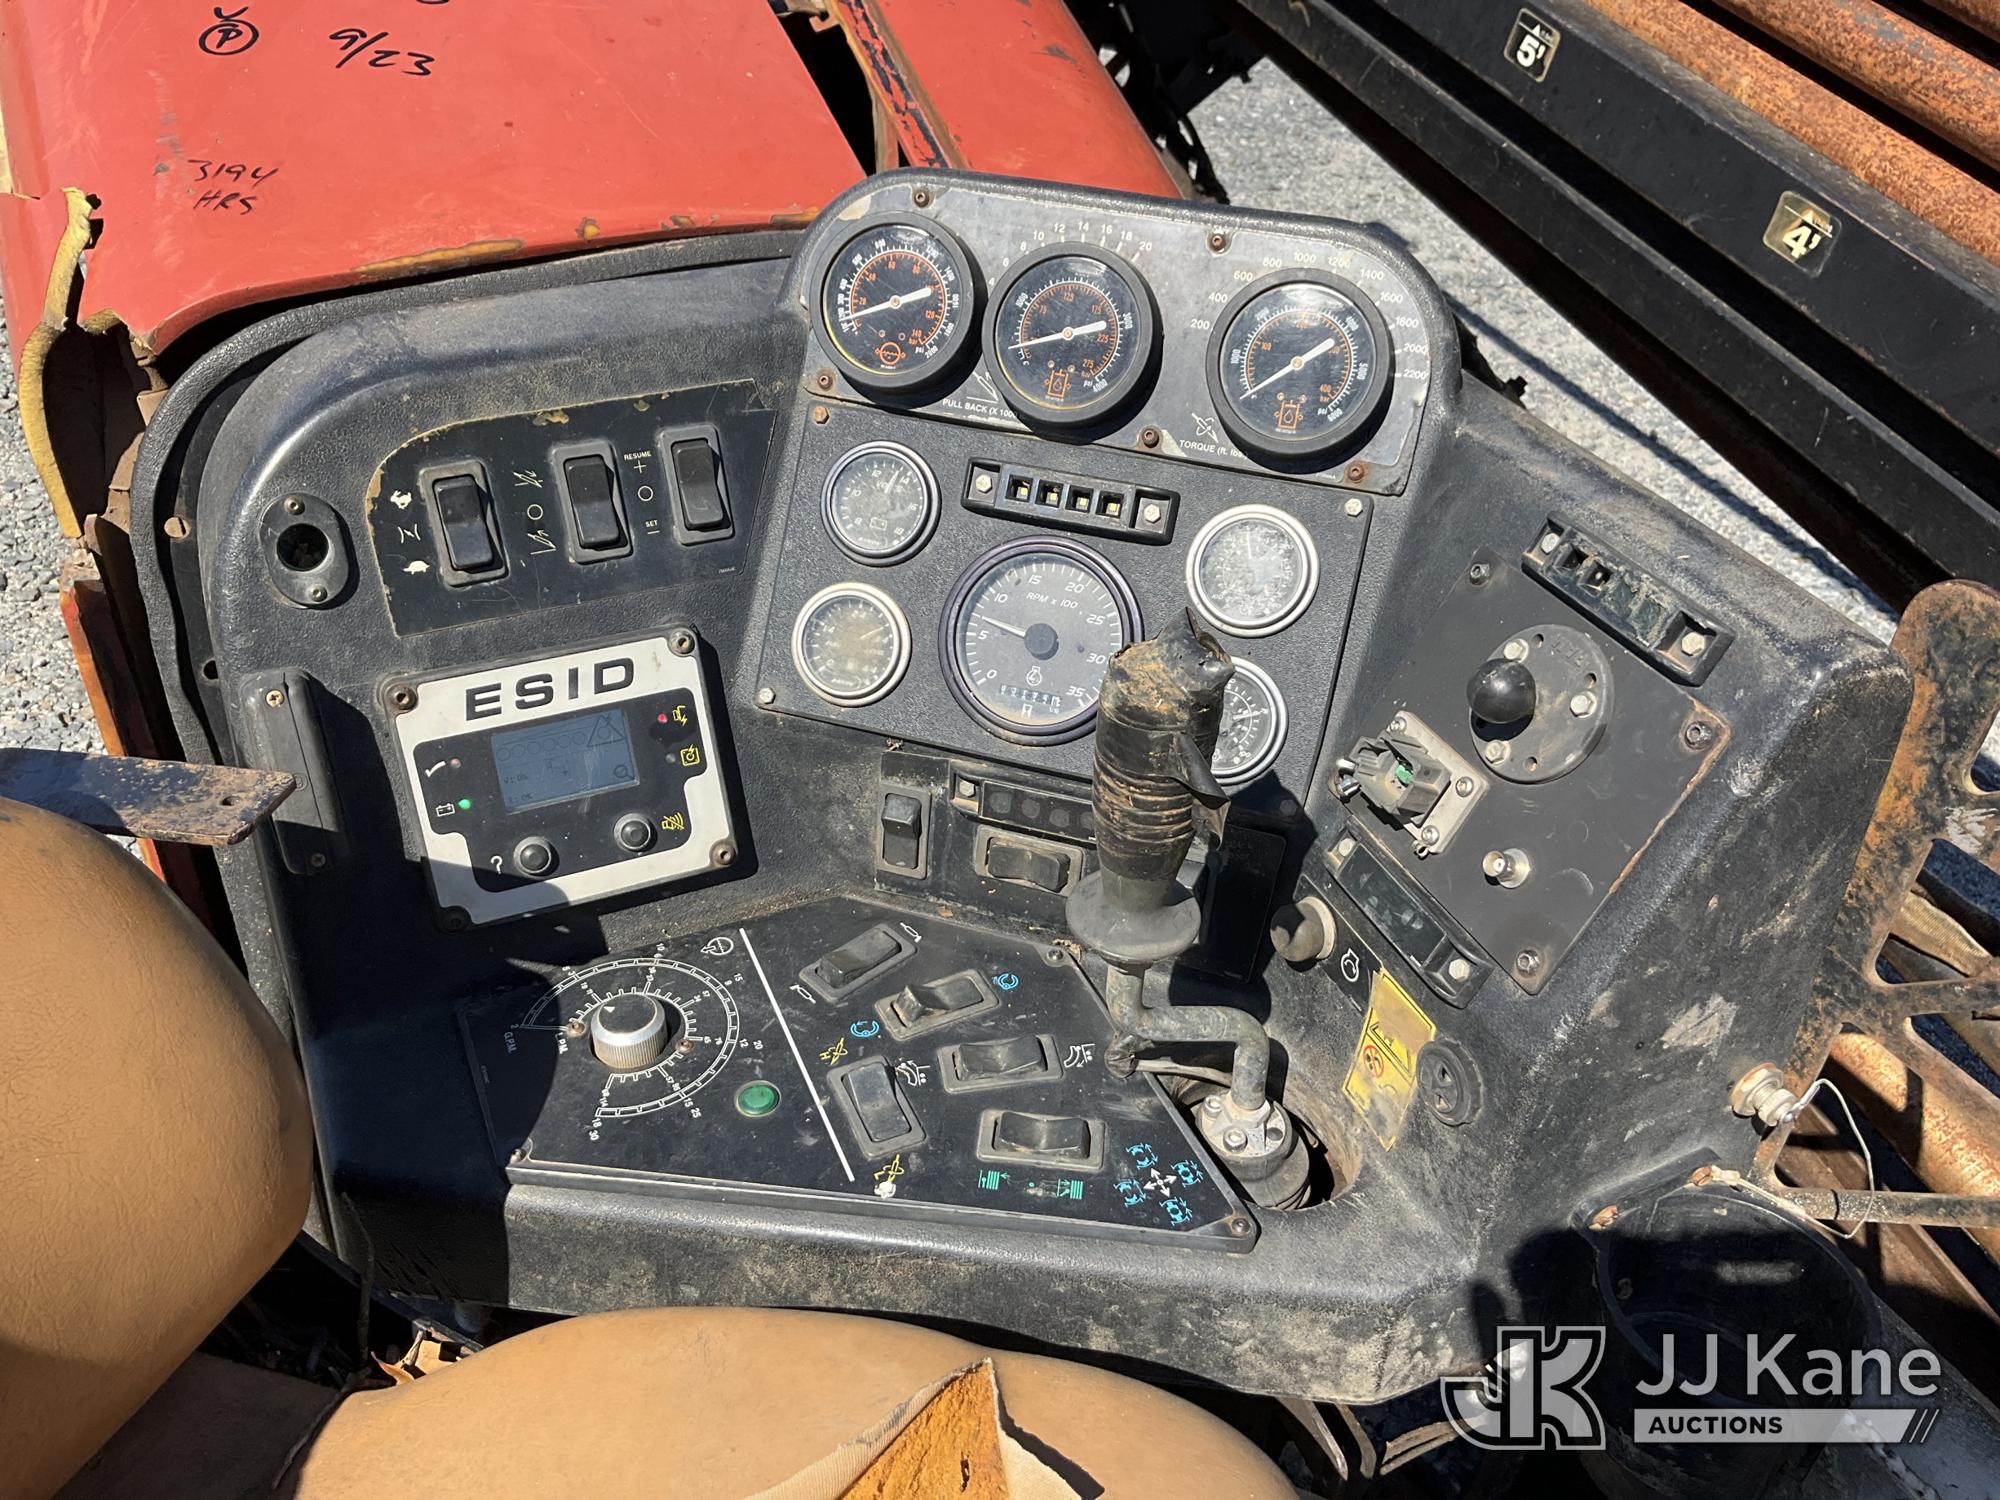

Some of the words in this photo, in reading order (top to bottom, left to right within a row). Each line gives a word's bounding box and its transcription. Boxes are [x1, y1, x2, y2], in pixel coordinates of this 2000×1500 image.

[329, 28, 435, 76] 9/23
[188, 159, 279, 188] 3194
[193, 190, 257, 215] HRS
[1054, 223, 1066, 233] 12
[1078, 222, 1089, 231] 14
[1101, 224, 1113, 234] 16
[1033, 231, 1045, 241] 10
[1121, 231, 1133, 241] 18
[1020, 242, 1027, 251] 8
[1139, 241, 1152, 251] 20
[1002, 258, 1009, 267] 6
[1262, 257, 1282, 268] 800
[1293, 253, 1317, 264] 1000
[1328, 255, 1351, 268] 1200
[1233, 270, 1253, 282] 600
[1360, 269, 1384, 281] 1400
[1063, 292, 1074, 301] 125
[1208, 292, 1228, 303] 400
[1379, 292, 1404, 303] 1600
[1190, 319, 1210, 330] 200
[1395, 317, 1419, 328] 1800
[1097, 334, 1109, 343] 225
[1403, 343, 1427, 354] 2000
[1231, 349, 1241, 365] 1000
[1083, 359, 1094, 368] 275
[1403, 368, 1426, 380] 2200
[942, 398, 963, 409] PULL
[964, 402, 988, 414] BACK
[988, 406, 998, 415] (X
[1179, 440, 1216, 453] TORQUE
[1217, 446, 1229, 457] (ft.
[623, 450, 652, 461] RESUME
[645, 519, 658, 528] SET
[1028, 574, 1043, 585] 15
[1065, 582, 1085, 593] 20
[993, 593, 1008, 603] 10
[1026, 592, 1049, 603] RPM
[1059, 598, 1079, 609] 100
[1086, 613, 1106, 625] 25
[978, 630, 989, 640] 5
[1086, 653, 1106, 664] 30
[986, 669, 997, 680] 0
[465, 657, 635, 722] ESID
[1066, 685, 1085, 697] 35
[656, 943, 665, 951] 10
[733, 973, 744, 982] 15
[580, 981, 588, 990] 19
[503, 1031, 517, 1054] GPM
[554, 1032, 569, 1055] LPM
[739, 1038, 749, 1048] 12
[753, 1040, 763, 1050] 20
[665, 1076, 674, 1084] 57
[683, 1097, 693, 1108] 15
[691, 1108, 702, 1118] 25
[591, 1118, 602, 1128] 18
[588, 1130, 600, 1141] 30
